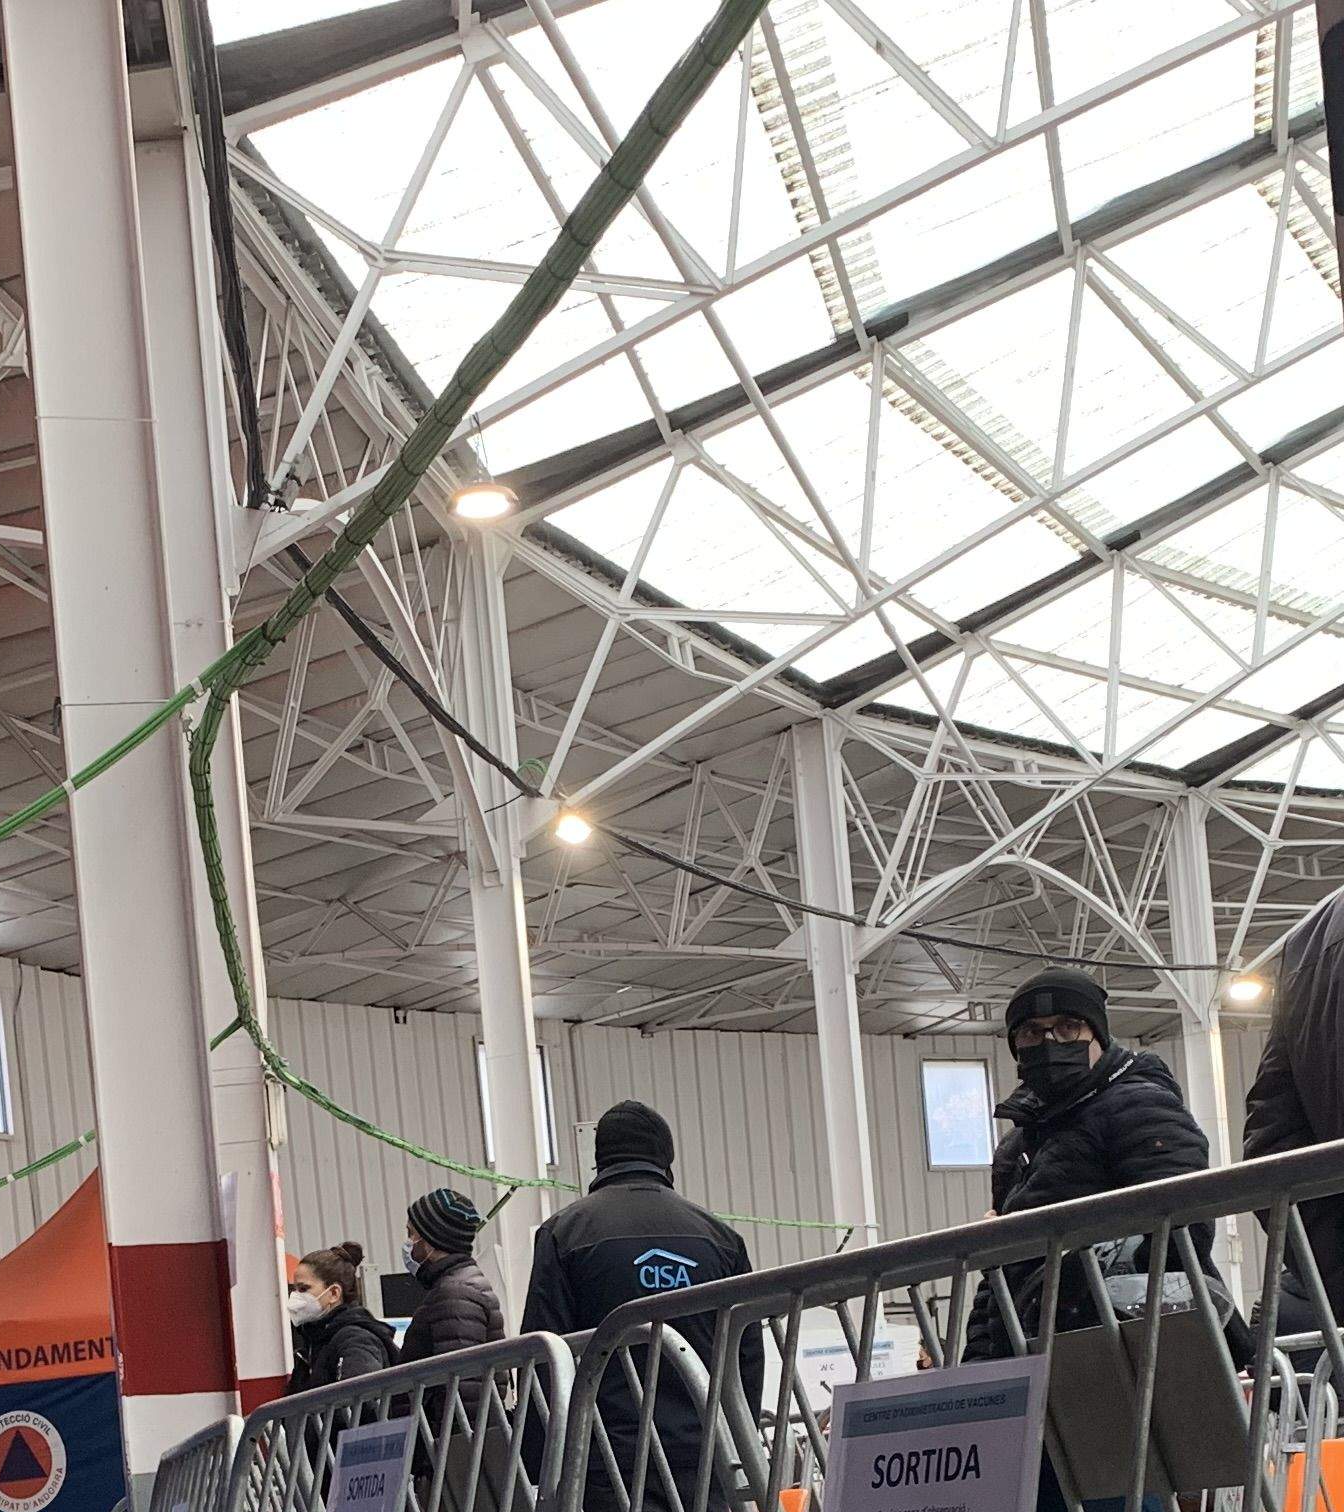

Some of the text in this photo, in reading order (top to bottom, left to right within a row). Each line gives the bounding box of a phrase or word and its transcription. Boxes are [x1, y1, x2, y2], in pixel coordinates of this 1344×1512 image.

[639, 1265, 691, 1289] CISA
[32, 1417, 51, 1437] CIVIL
[871, 1444, 981, 1489] SORTIDA
[347, 1473, 386, 1502] SORTIDA
